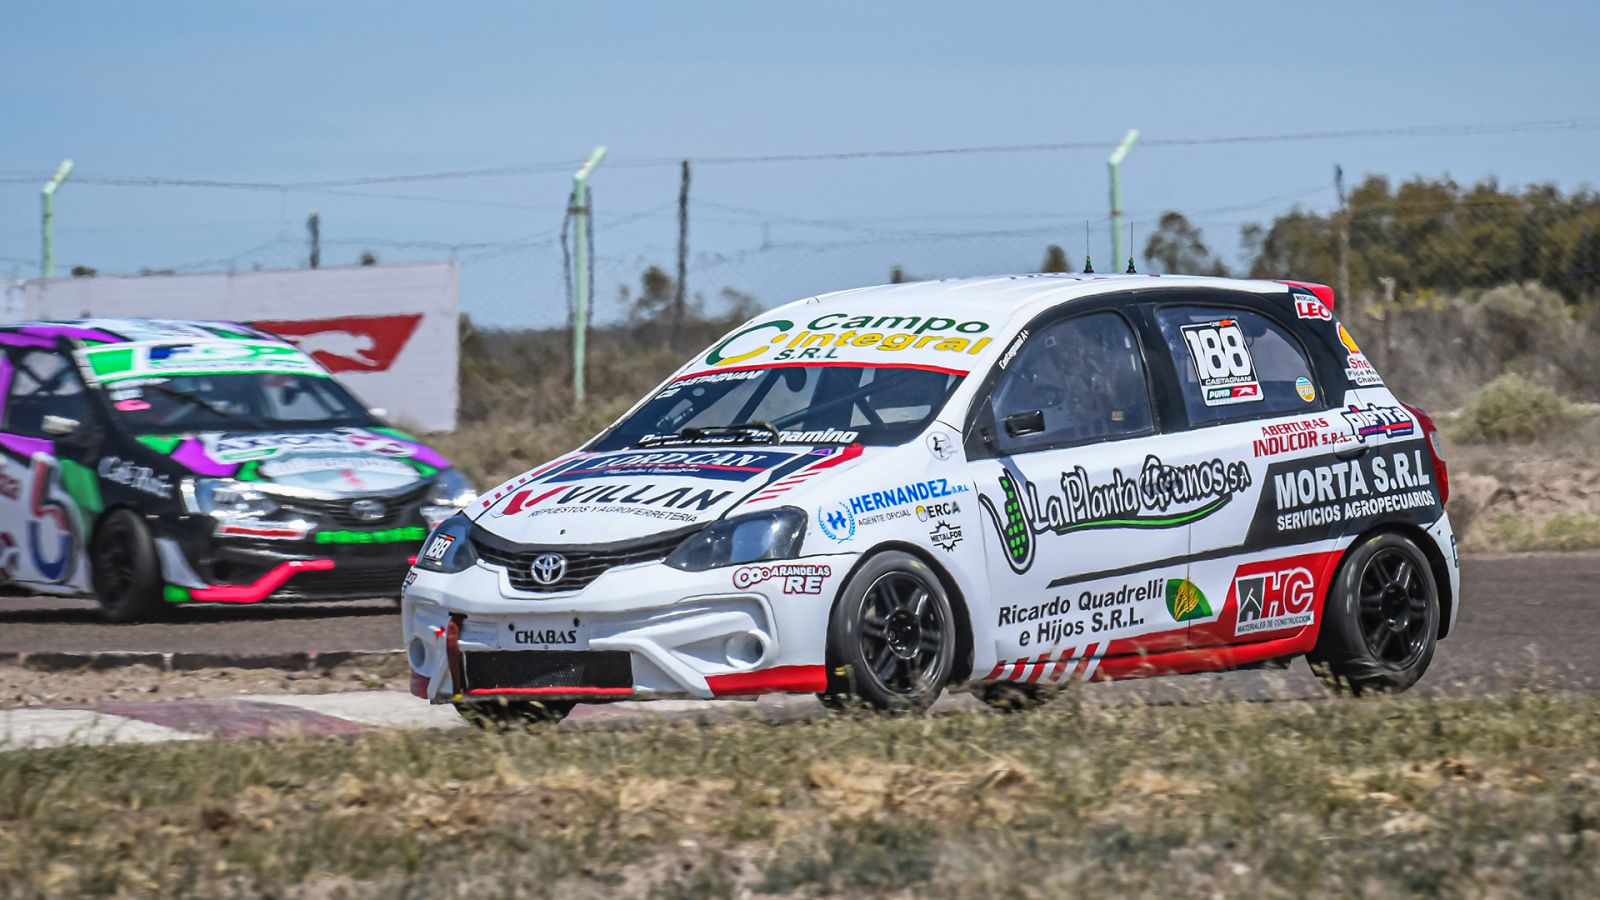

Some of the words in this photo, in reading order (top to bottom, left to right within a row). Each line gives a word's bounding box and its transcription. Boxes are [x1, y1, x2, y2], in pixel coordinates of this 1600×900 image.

[1296, 302, 1331, 319] LEO
[807, 313, 990, 335] Campo
[786, 330, 993, 355] Integral
[774, 347, 839, 360] S.R.L
[1185, 326, 1251, 380] 188
[1349, 357, 1371, 369] She
[1205, 376, 1252, 385] CASTAGNANI
[1208, 388, 1231, 399] PUMA
[1261, 417, 1330, 437] ABERTURAS
[1252, 430, 1319, 457] INDUCOR
[1274, 460, 1370, 510] MORTA
[1372, 450, 1430, 493] S.R.L
[849, 478, 951, 515] HERNANDEZ
[528, 505, 590, 518] REPUESTOS
[858, 514, 886, 526] AGENTE
[886, 509, 912, 521] OFICIAL
[1277, 504, 1341, 531] SERVICIOS
[1344, 490, 1436, 521] AGROPECUARIOS
[930, 530, 963, 542] METALFOR
[425, 537, 452, 559] 188
[771, 565, 832, 578] ARANDELAS
[784, 577, 822, 594] RE
[998, 596, 1071, 627] Ricardo
[1078, 578, 1164, 610] Quadrelli
[1019, 630, 1031, 647] e
[1036, 619, 1085, 645] Hijos
[1091, 606, 1145, 633] S.R.L.
[1237, 621, 1266, 633] MATERIALES
[514, 629, 577, 645] CHABAS
